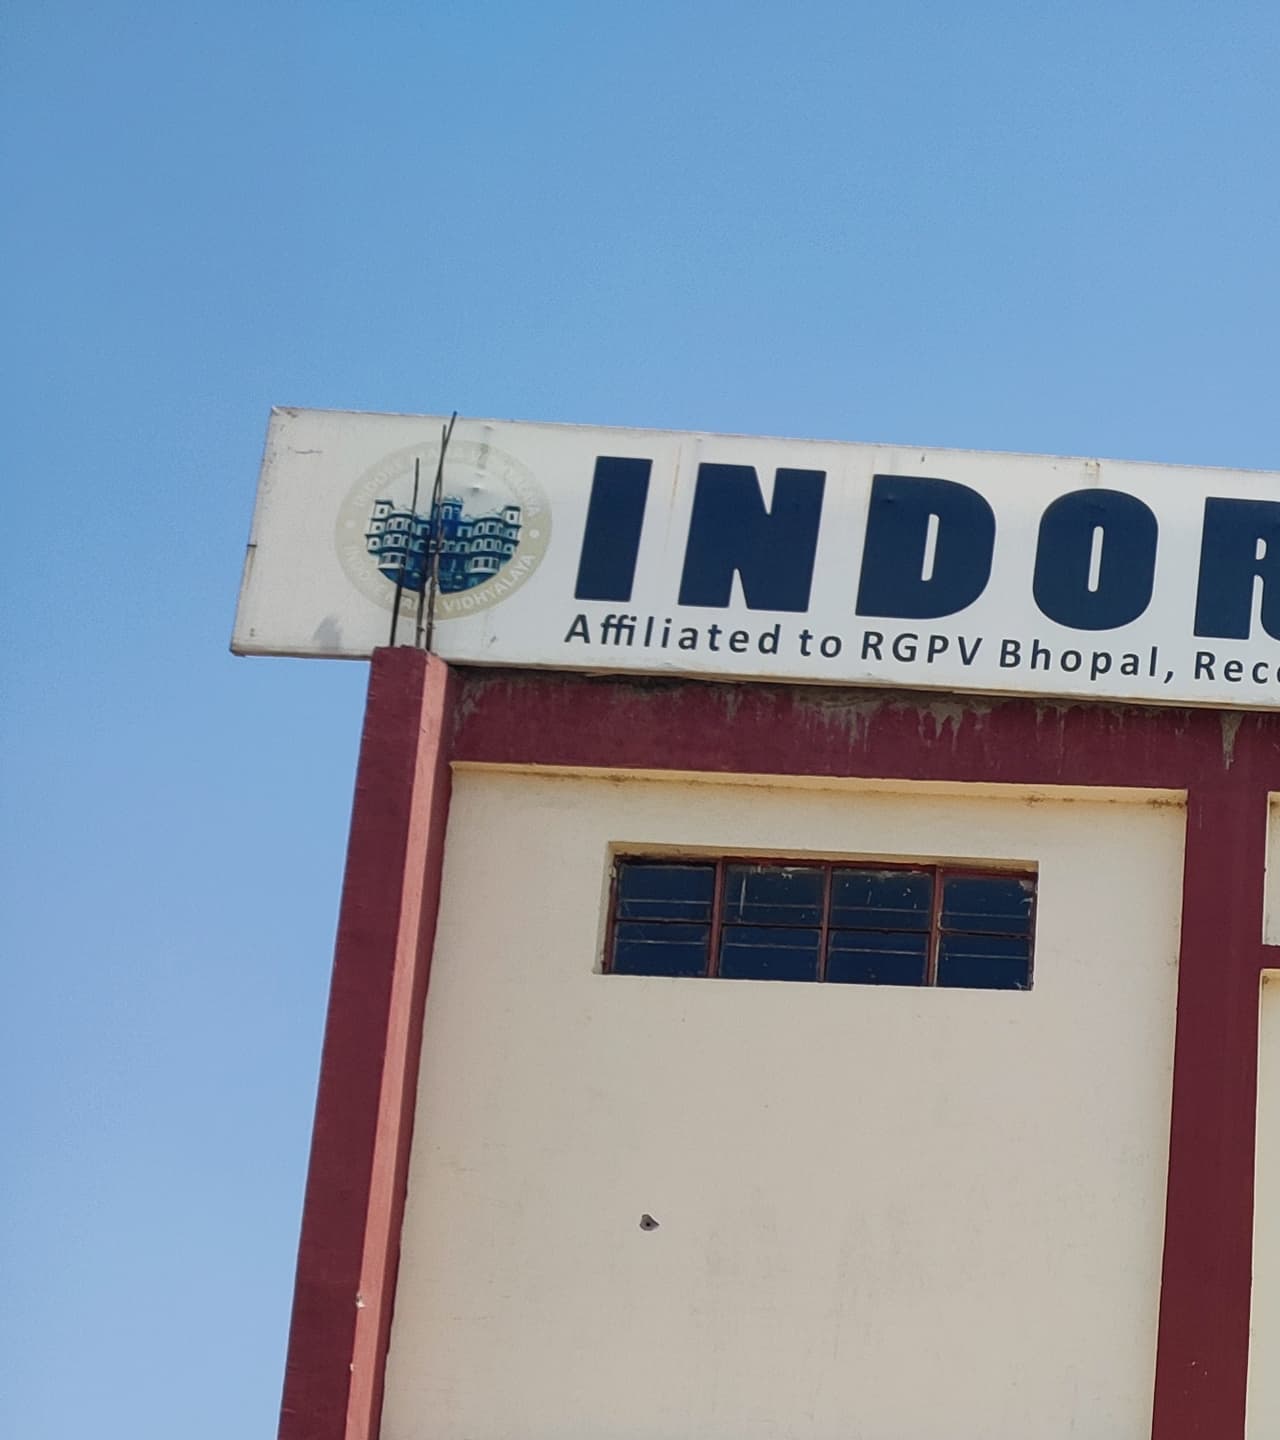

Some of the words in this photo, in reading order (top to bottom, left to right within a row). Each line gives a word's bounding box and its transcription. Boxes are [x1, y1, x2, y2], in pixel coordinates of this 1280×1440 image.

[564, 613, 781, 655] Affiliated
[798, 629, 842, 658] to
[861, 630, 983, 666] RGPV
[999, 638, 1174, 684] Bhopal,
